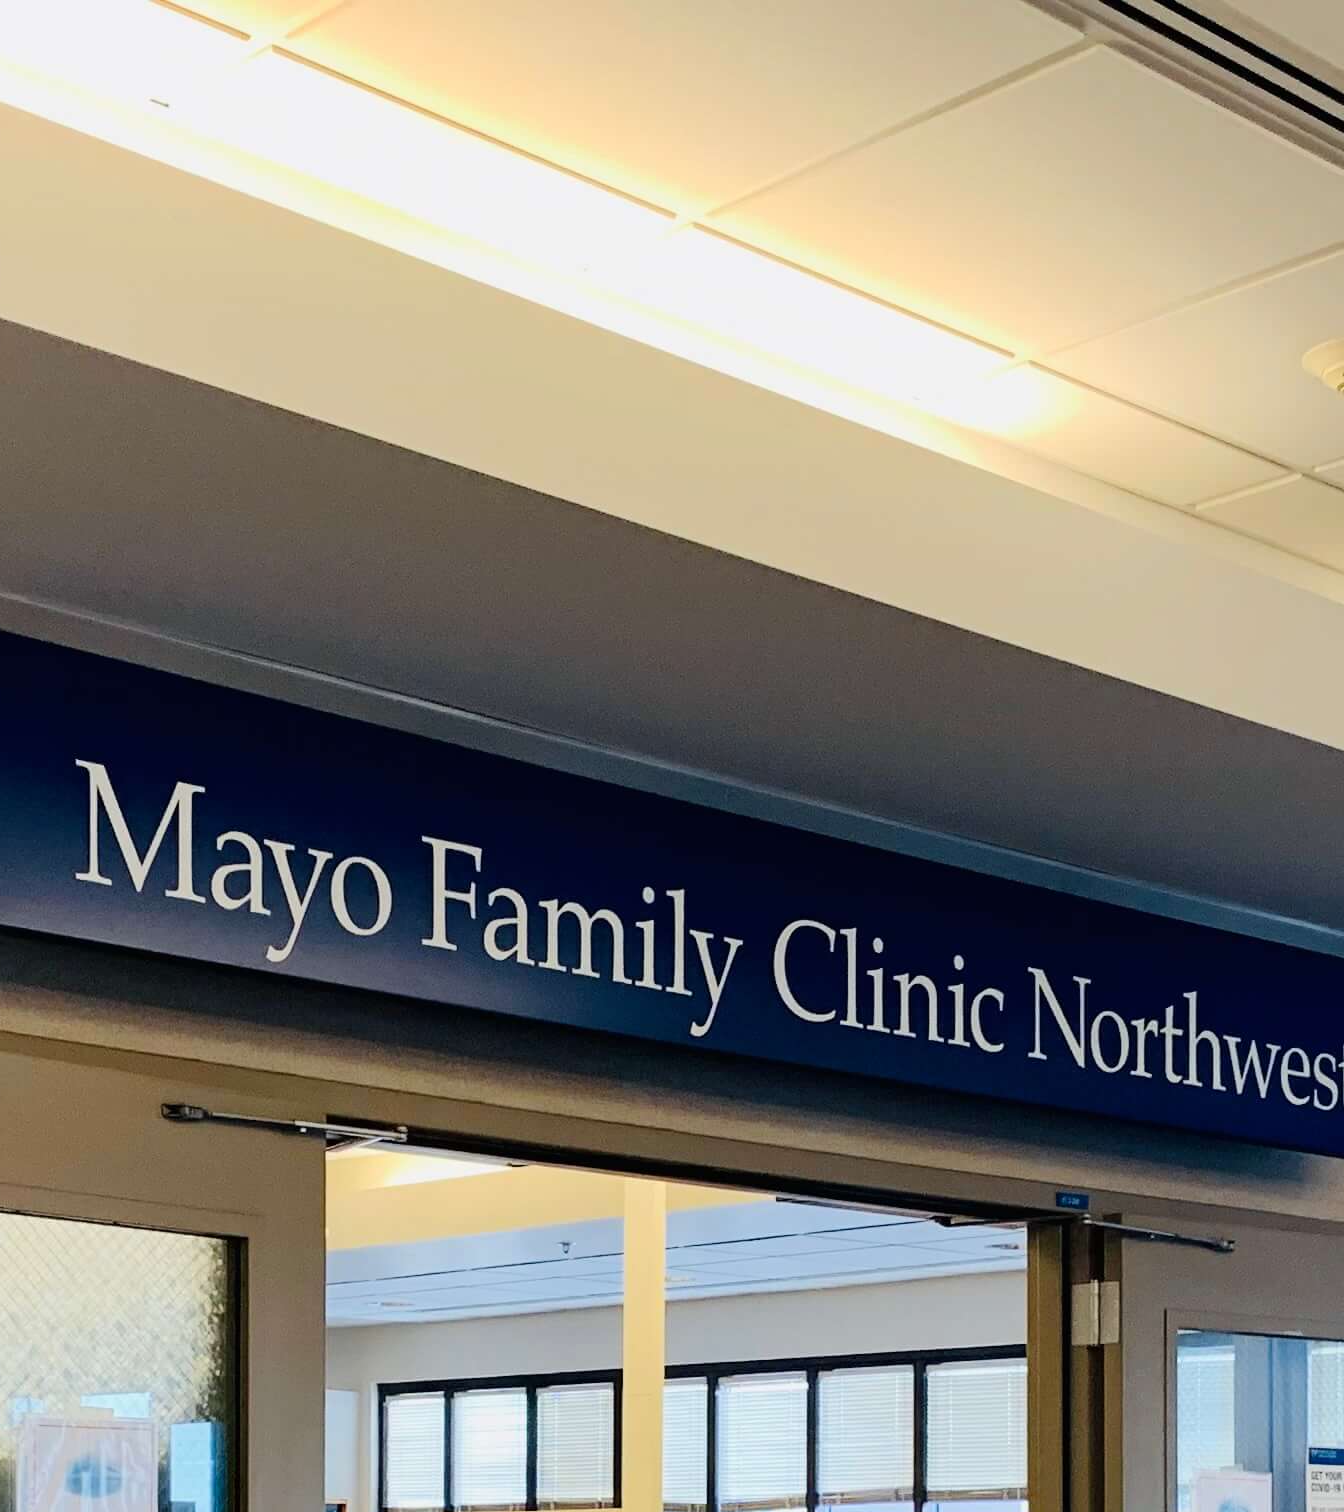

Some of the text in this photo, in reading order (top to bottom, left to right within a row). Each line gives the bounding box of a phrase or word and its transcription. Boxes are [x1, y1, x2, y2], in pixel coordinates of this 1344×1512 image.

[75, 758, 392, 963] Mayo
[421, 835, 744, 1037] Family
[773, 919, 1005, 1053] Clinic
